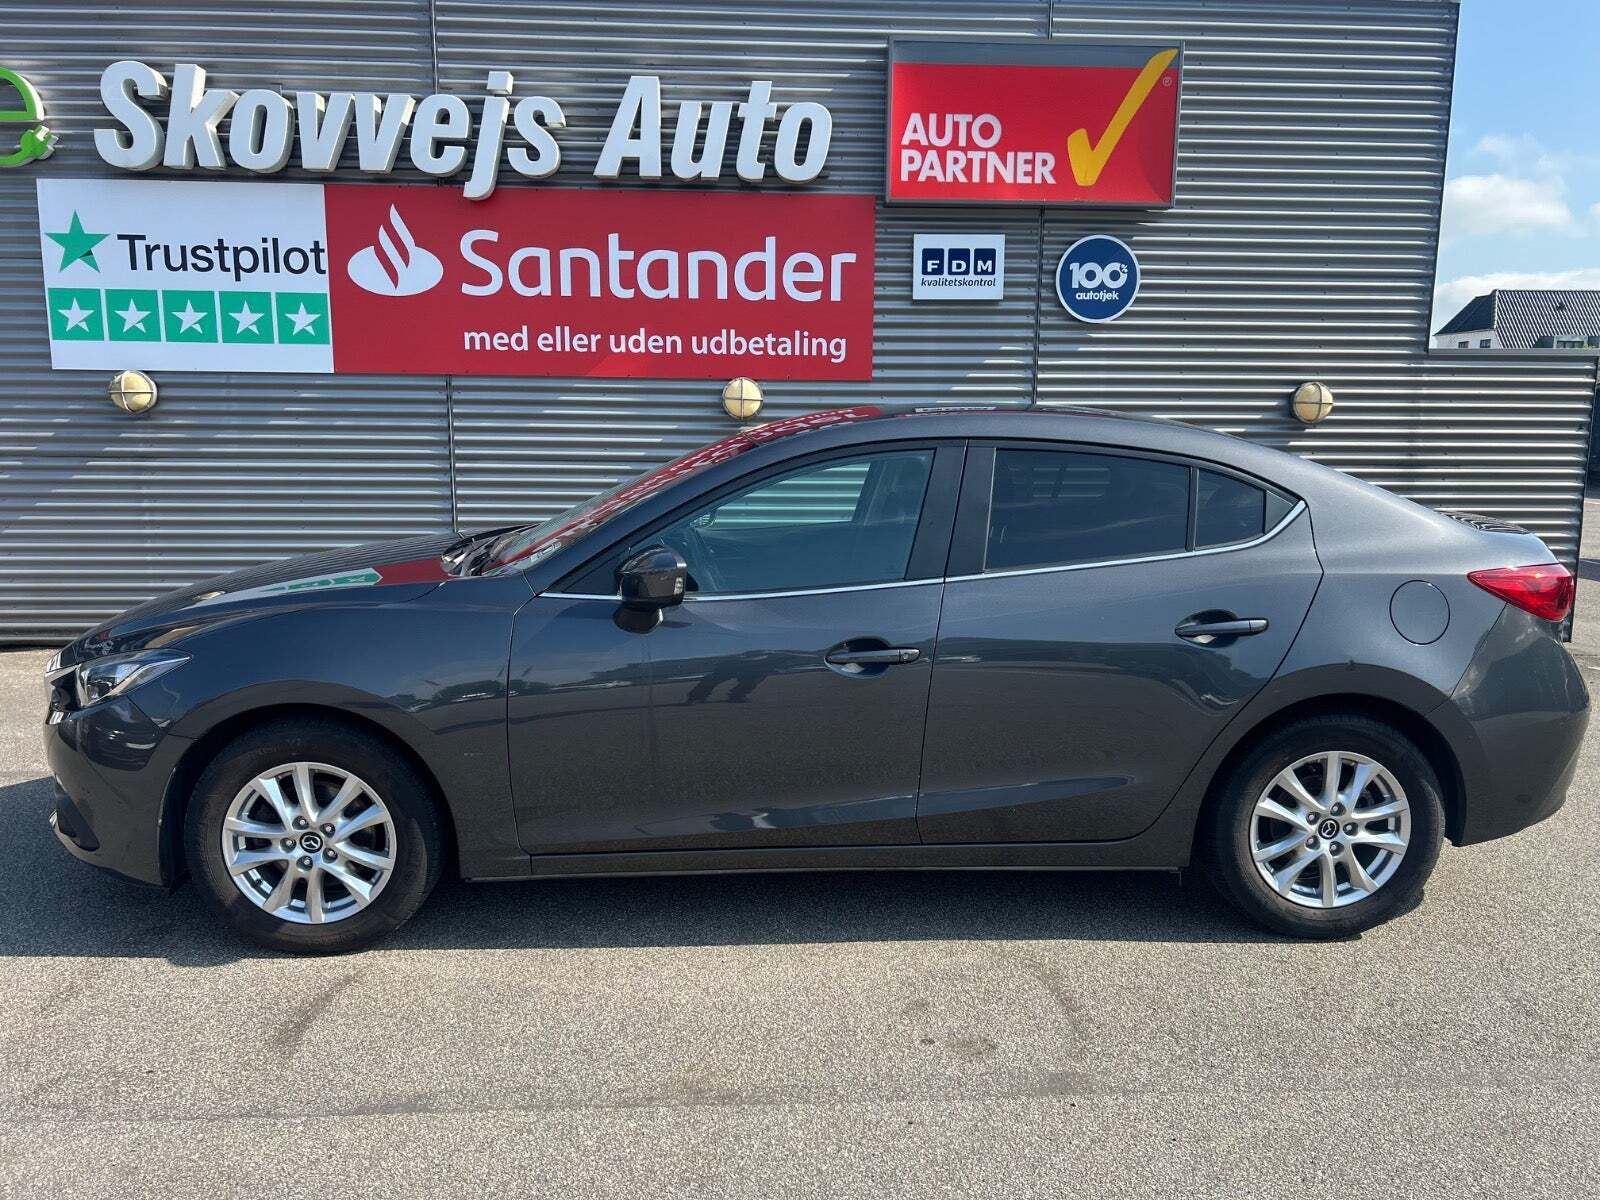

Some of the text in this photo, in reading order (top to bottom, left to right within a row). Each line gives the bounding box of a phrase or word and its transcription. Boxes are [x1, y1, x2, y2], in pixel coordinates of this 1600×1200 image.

[94, 60, 833, 201] Skovvejs Auto
[901, 112, 1002, 148] AUTO
[900, 149, 1057, 185] PARTNER
[117, 233, 327, 282] Trustpilot
[459, 228, 857, 302] Santander
[926, 259, 993, 273] FDM
[921, 277, 996, 288] kvalitetskontrol
[1075, 290, 1119, 302] autotjek
[463, 325, 847, 363] med eller uden udbetaling
